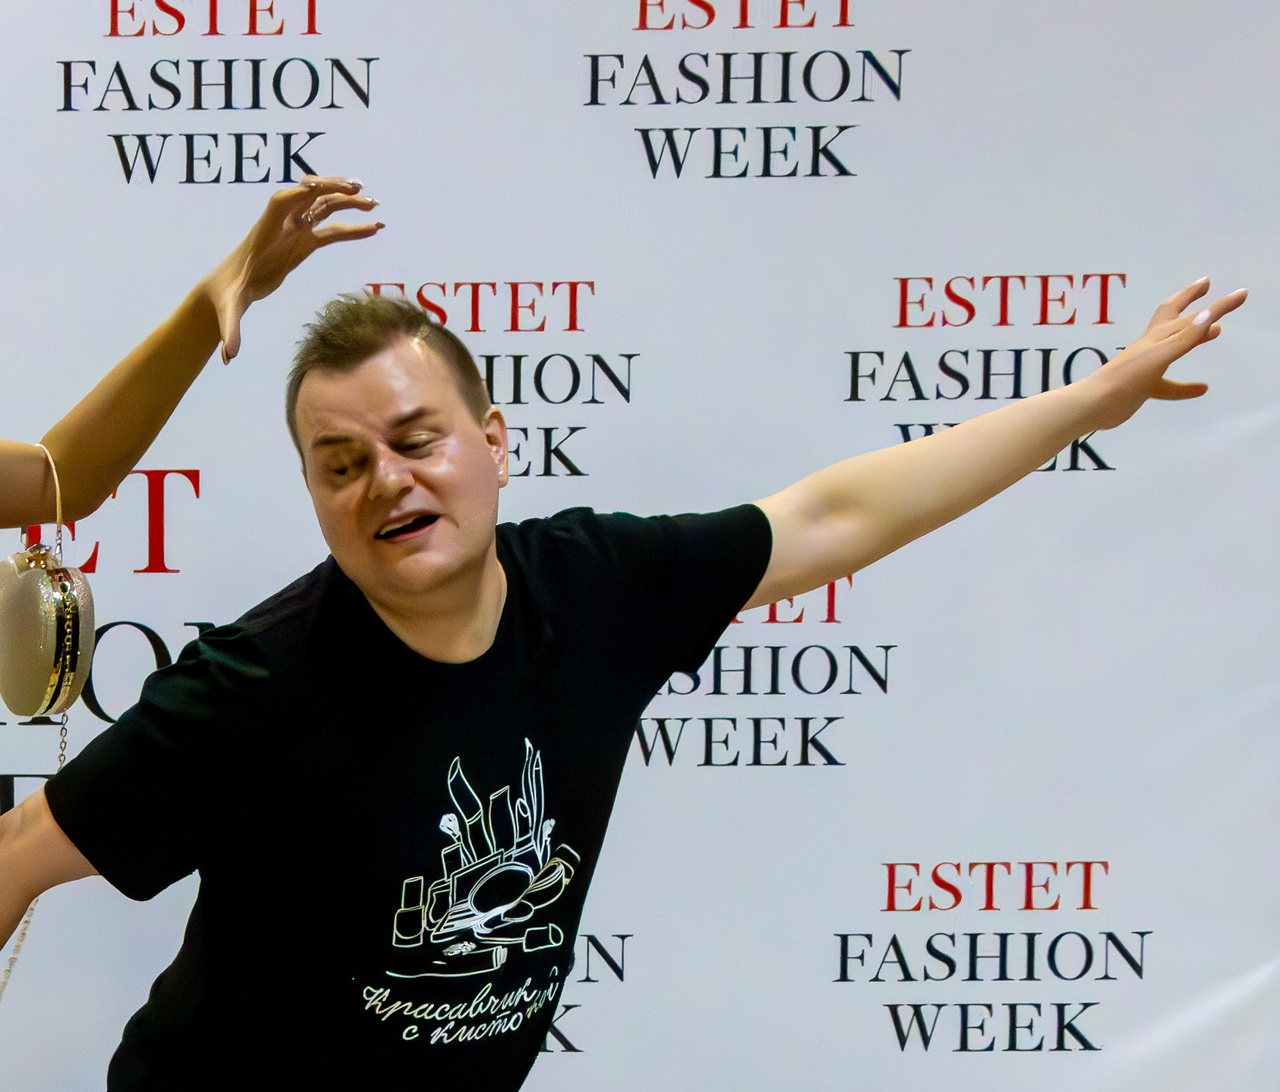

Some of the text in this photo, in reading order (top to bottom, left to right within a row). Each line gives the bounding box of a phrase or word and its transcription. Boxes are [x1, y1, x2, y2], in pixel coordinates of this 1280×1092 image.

[56, 58, 380, 112] FASHION
[583, 49, 912, 106] FASHION
[110, 132, 327, 184] WEEK
[634, 125, 858, 179] WEEK
[365, 281, 596, 333] STET
[893, 273, 1126, 328] ESTET
[843, 346, 1126, 402] FASHIO
[635, 716, 846, 767] WEEK
[880, 861, 1109, 911] ESTET
[833, 931, 1153, 982] FASHION
[883, 1002, 1102, 1052] WEEK
